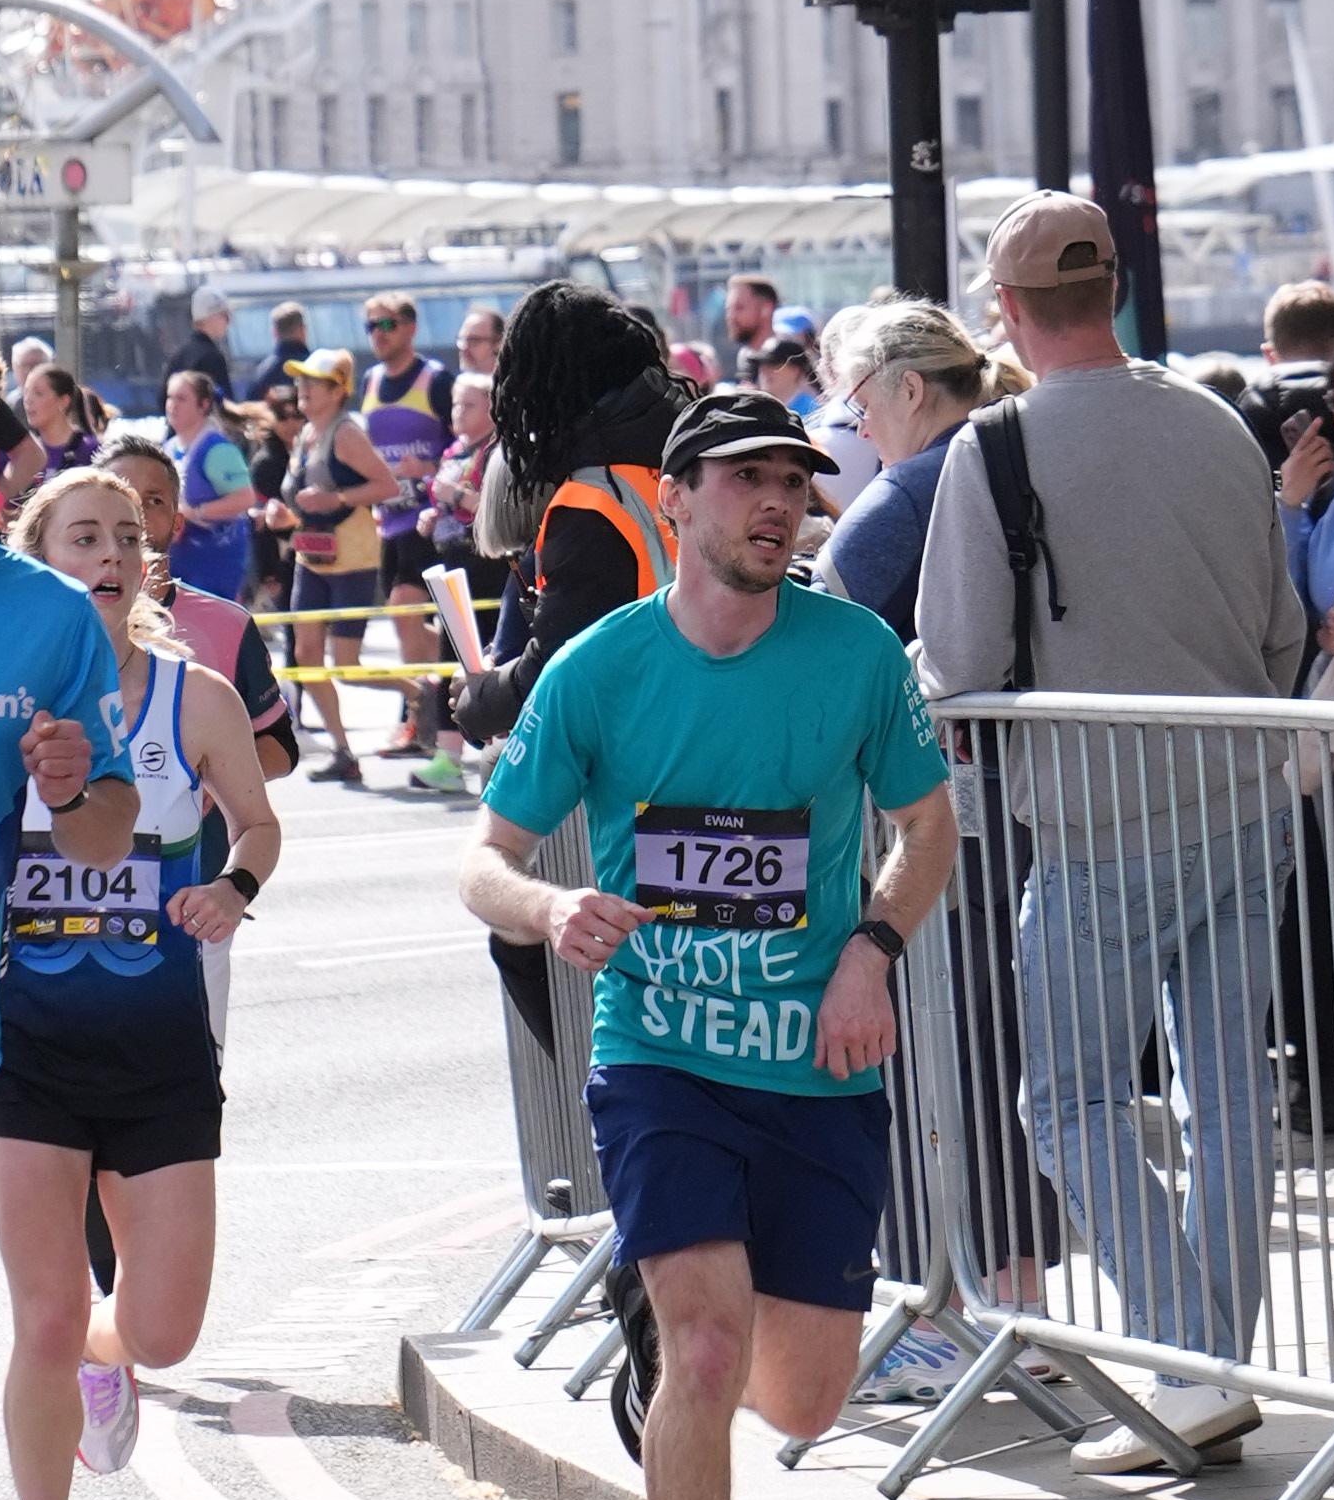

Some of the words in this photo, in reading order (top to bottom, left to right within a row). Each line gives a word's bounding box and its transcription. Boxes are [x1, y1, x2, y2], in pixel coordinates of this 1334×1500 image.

[704, 814, 745, 829] EWAN
[25, 863, 137, 903] 2104
[666, 841, 783, 887] 1726
[641, 983, 812, 1062] STEAD
